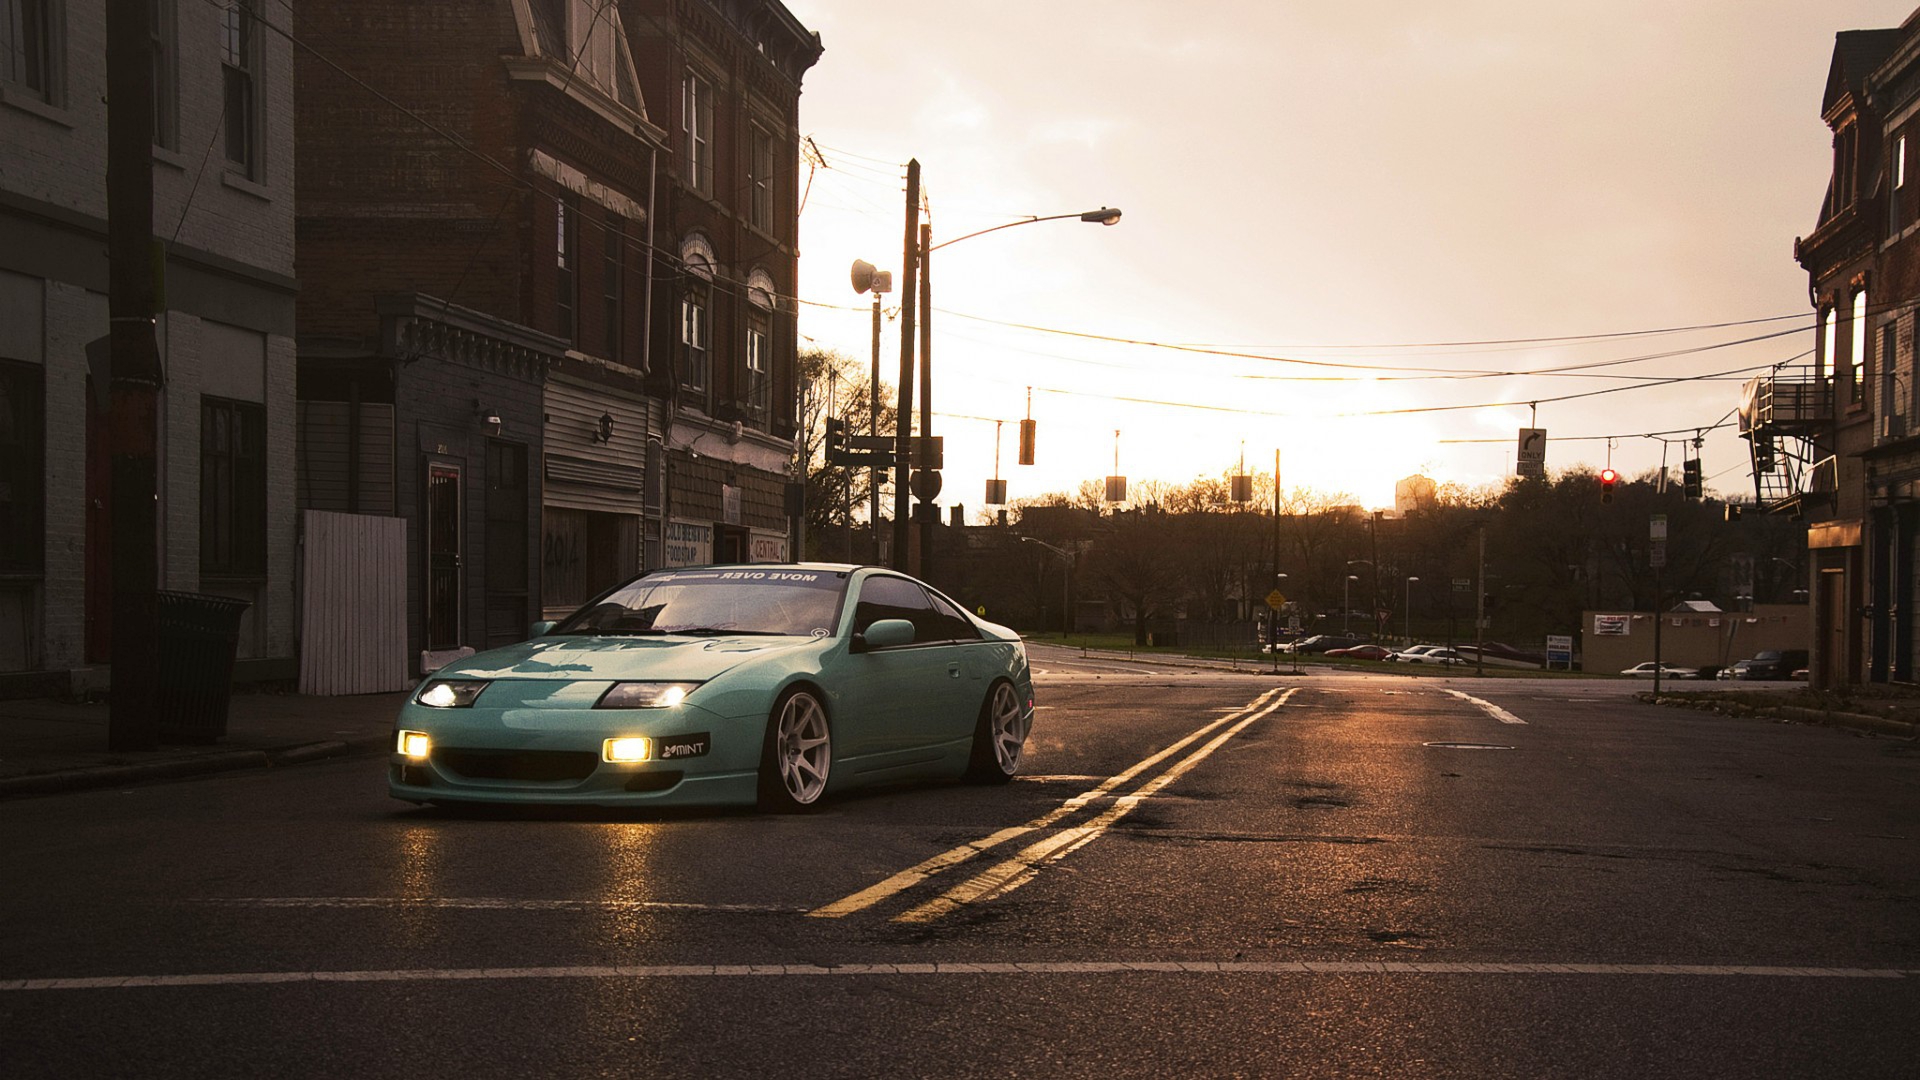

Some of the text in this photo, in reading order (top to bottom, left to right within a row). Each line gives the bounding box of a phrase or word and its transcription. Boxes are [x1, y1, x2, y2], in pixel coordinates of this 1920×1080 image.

[1521, 451, 1542, 459] ONLY
[667, 545, 681, 562] FOOD
[756, 540, 779, 560] CENTRAL
[676, 742, 704, 756] MINT
